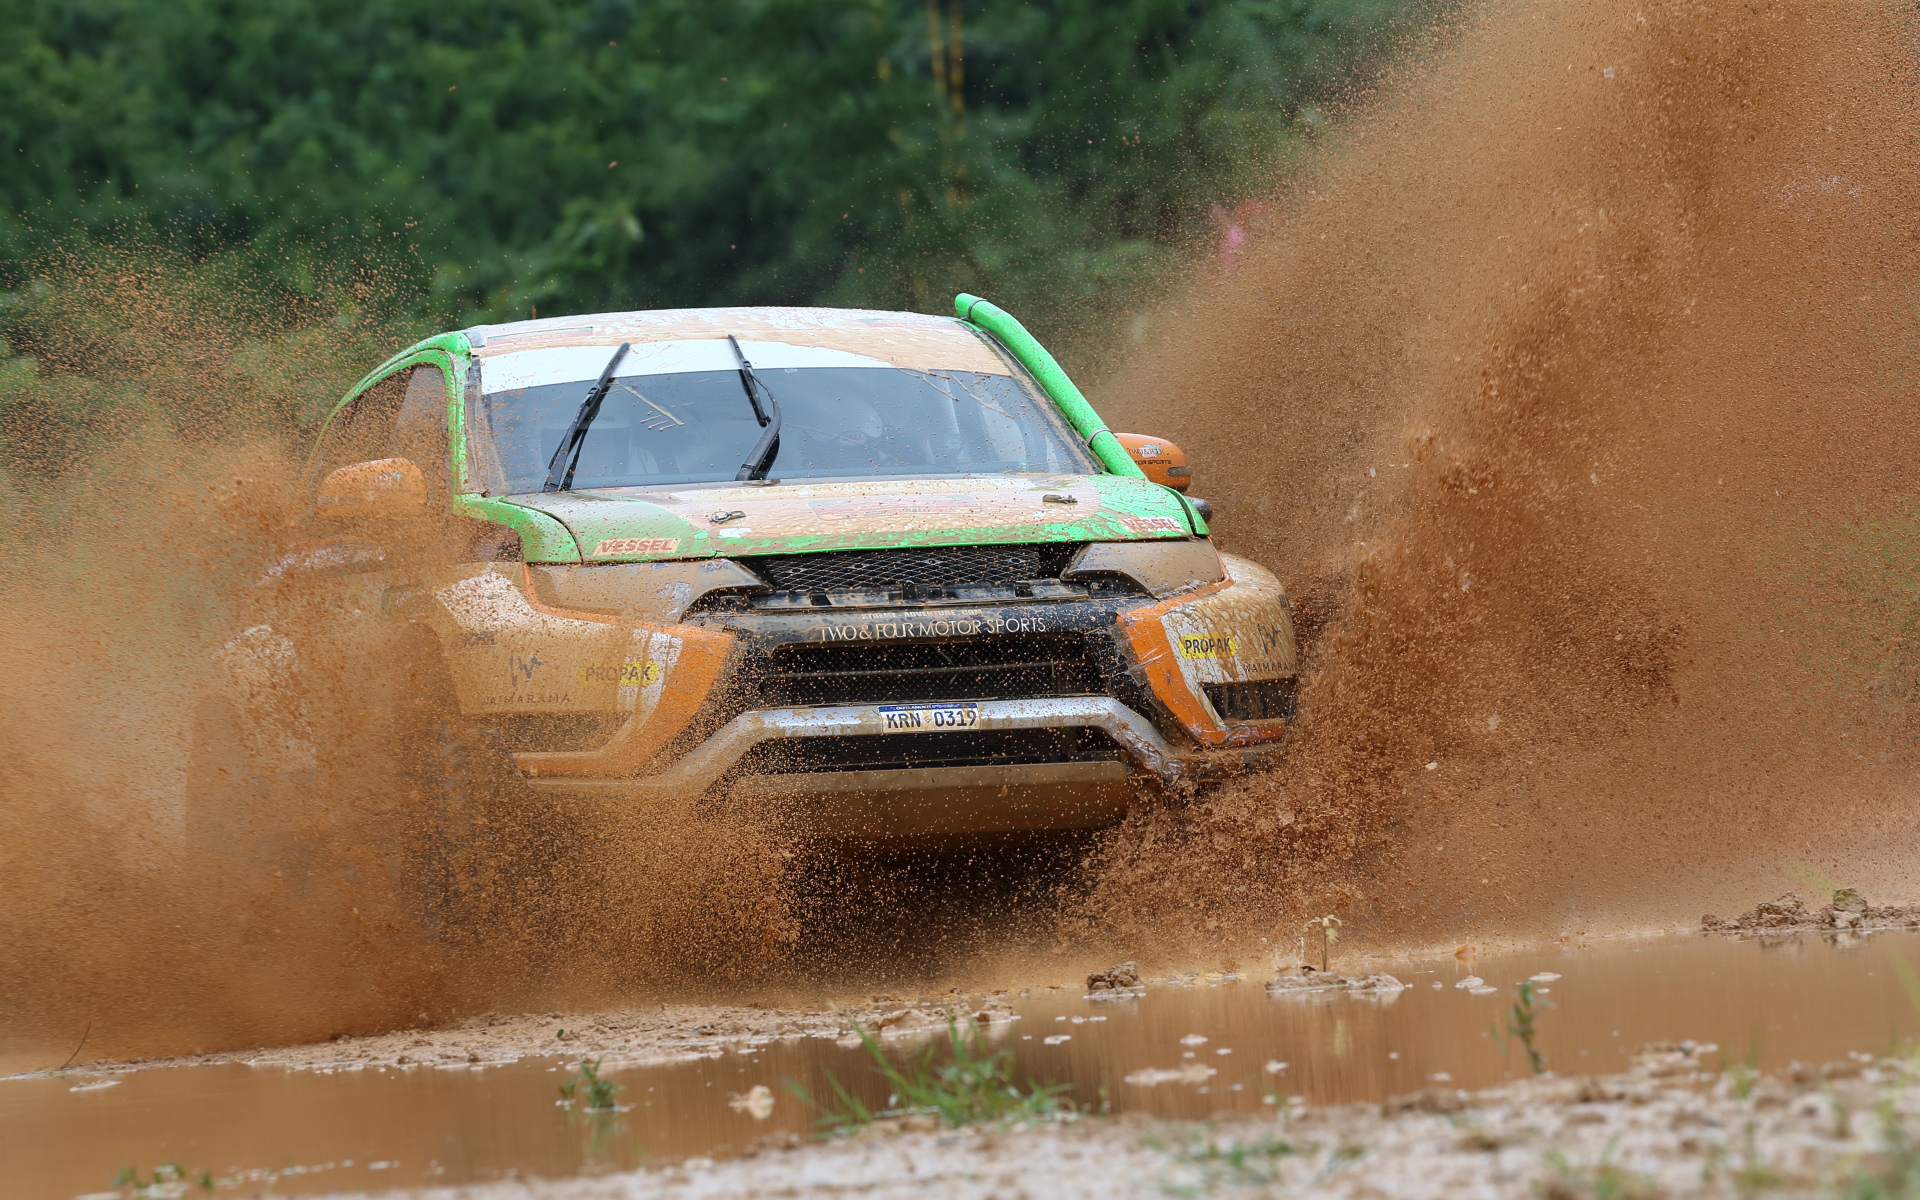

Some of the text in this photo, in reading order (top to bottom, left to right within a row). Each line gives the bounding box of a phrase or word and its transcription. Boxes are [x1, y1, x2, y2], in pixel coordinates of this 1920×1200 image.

[1122, 519, 1180, 531] VESSEL
[600, 539, 673, 553] VESSEL
[820, 617, 1046, 641] TWO & FOUR MOTOR SPORTS
[1185, 637, 1233, 654] PROPAK
[585, 666, 651, 682] PROPAK
[886, 710, 977, 729] KRN 0319
